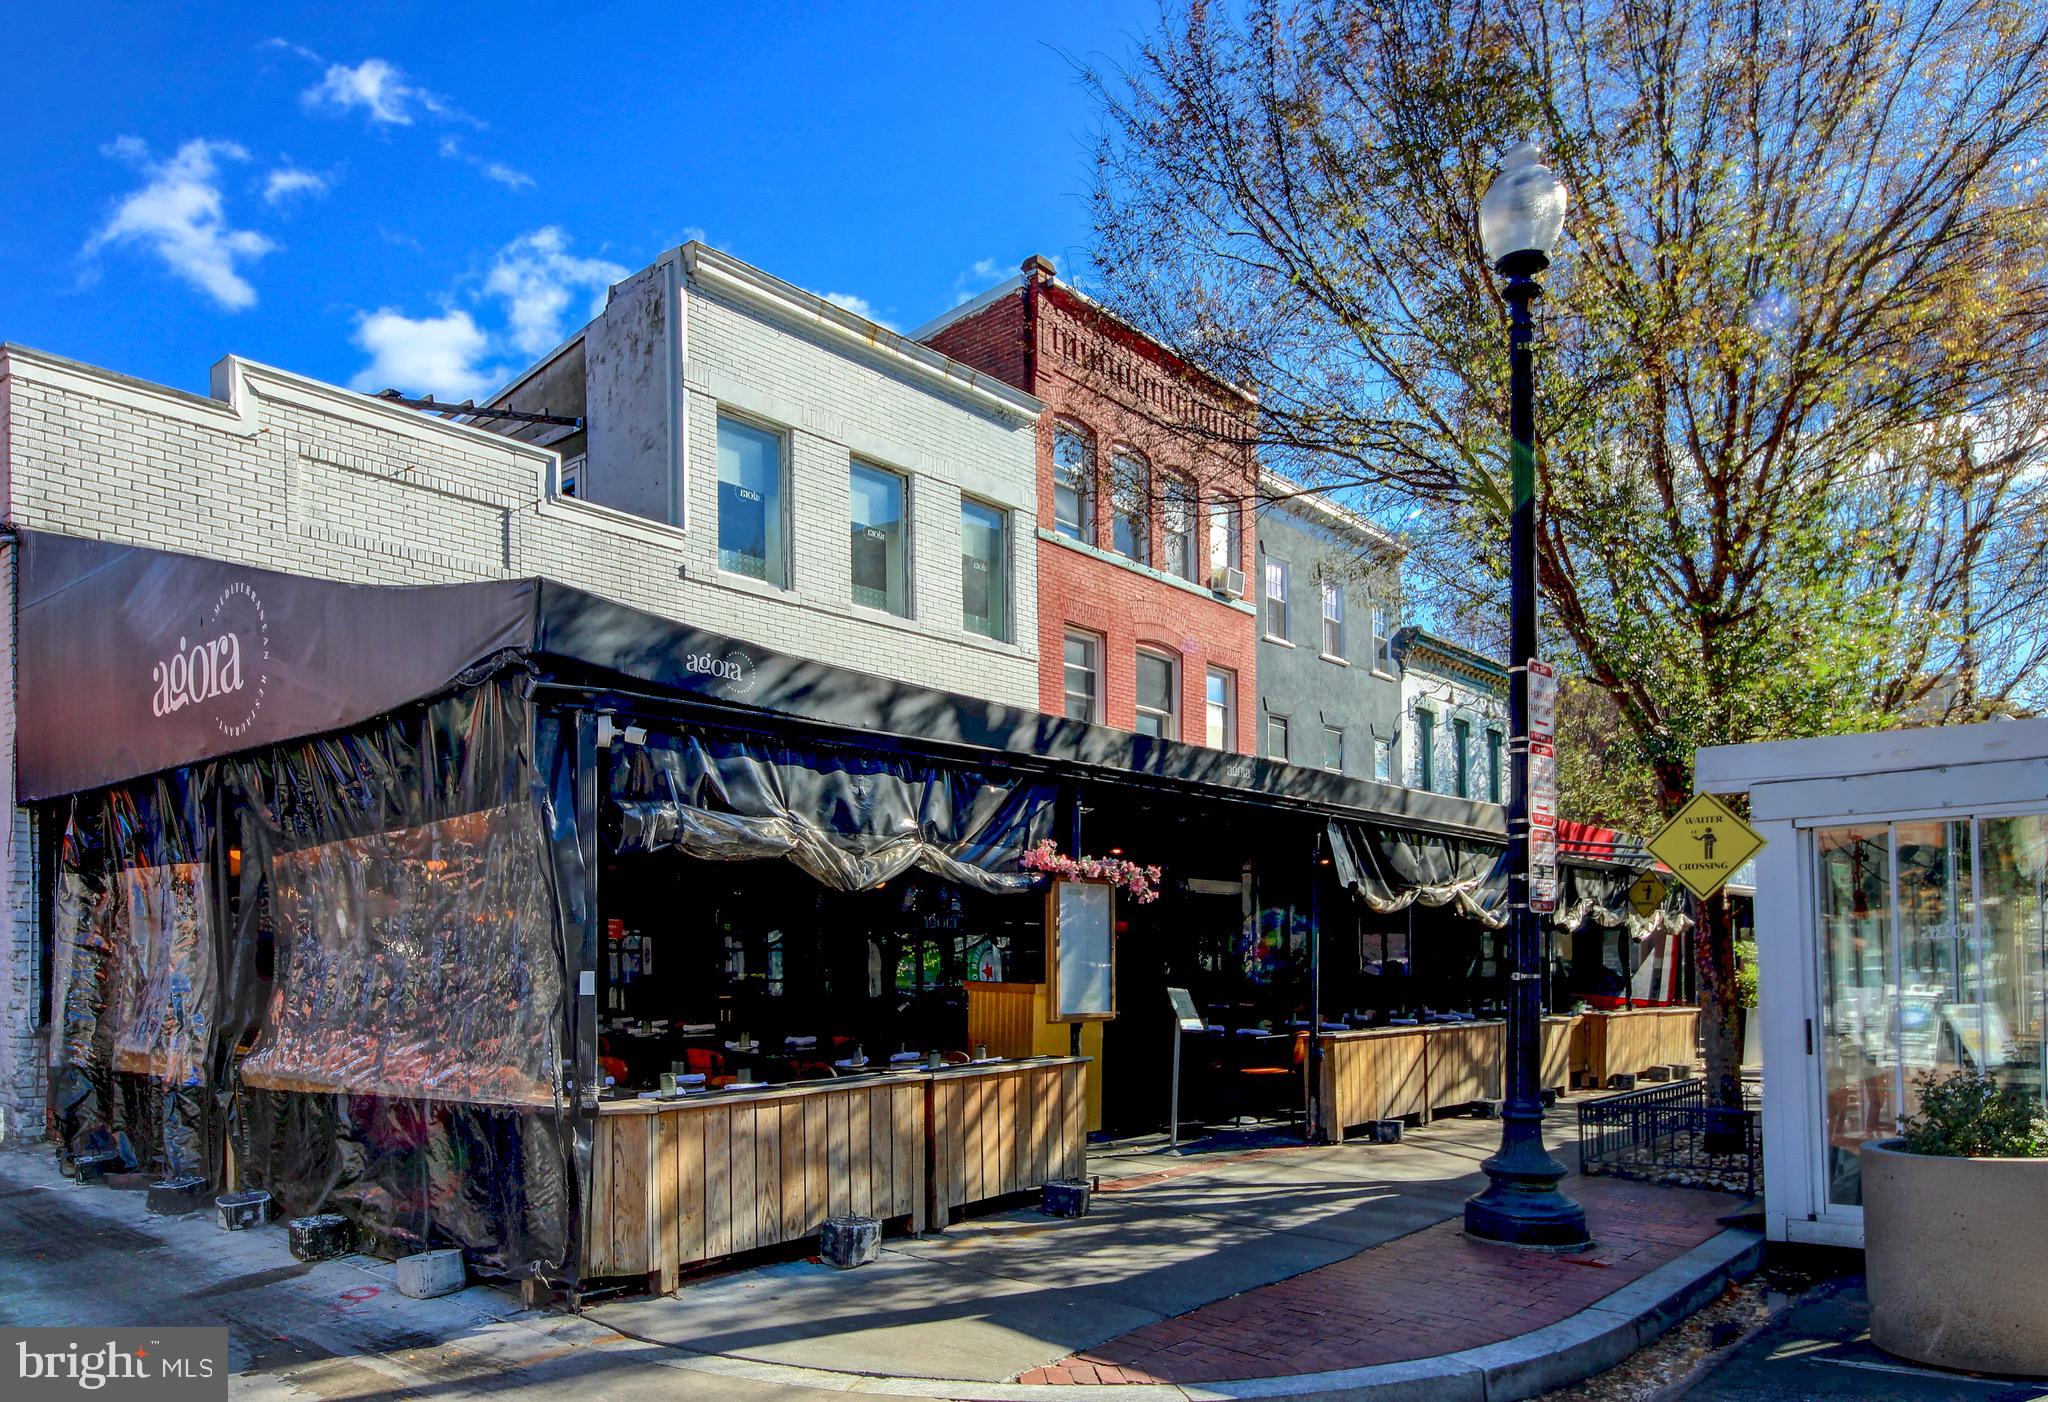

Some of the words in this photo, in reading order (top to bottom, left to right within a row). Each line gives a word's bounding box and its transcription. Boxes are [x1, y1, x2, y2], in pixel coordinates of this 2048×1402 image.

[214, 582, 269, 660] MEDITERRANEAN
[153, 632, 244, 717] agora
[686, 652, 743, 682] agora
[217, 674, 267, 737] RESTAURANT
[1227, 763, 1251, 779] agora
[1684, 816, 1722, 825] WAITER
[1678, 862, 1728, 871] CROSSING
